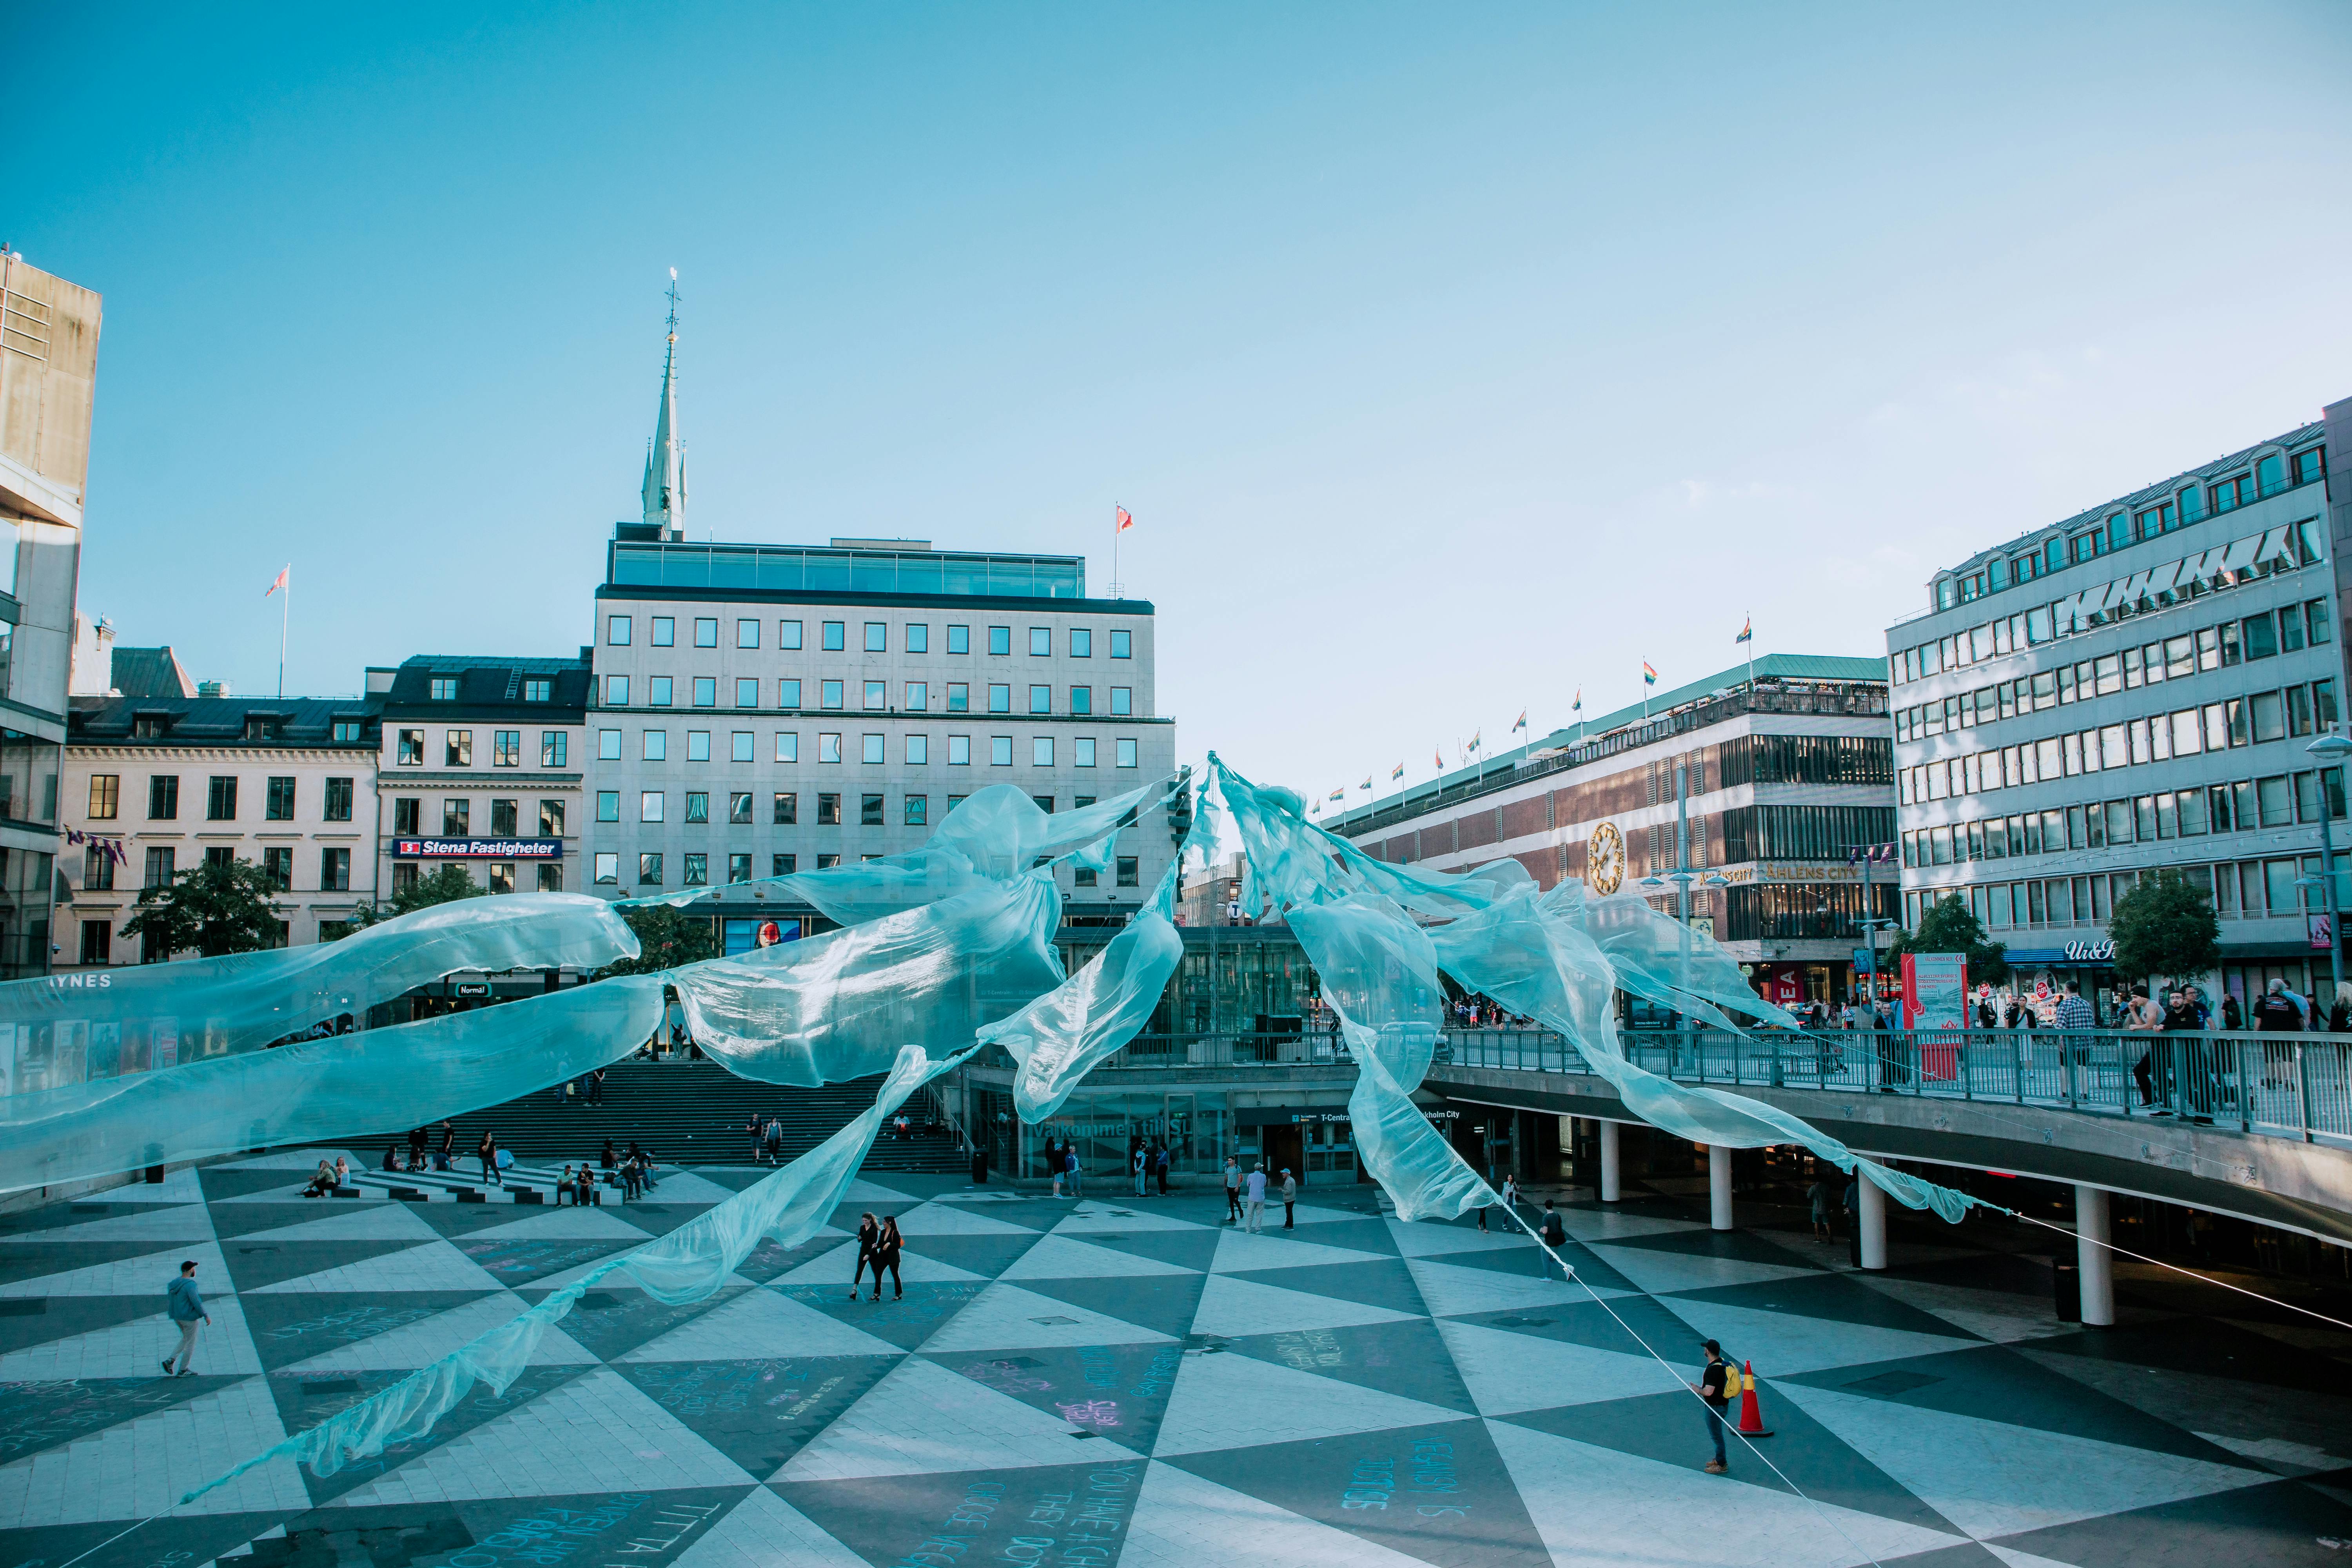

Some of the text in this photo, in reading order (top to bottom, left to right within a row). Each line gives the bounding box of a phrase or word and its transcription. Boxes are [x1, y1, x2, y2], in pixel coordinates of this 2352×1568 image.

[423, 841, 467, 854] Stena
[470, 842, 554, 856] Fastigheter
[1733, 868, 1752, 881] CITY
[1828, 867, 1859, 879] CITY
[461, 985, 485, 994] Normal
[1780, 971, 1795, 998] EA
[1141, 1119, 1164, 1136] till
[1169, 1119, 1194, 1136] SL
[1129, 1378, 1175, 1397] GAY
[1407, 1436, 1461, 1494] VEGANISM
[1089, 1465, 1136, 1492] YOU
[944, 1482, 1007, 1529] CHOOSE
[1026, 1491, 1074, 1528] THEY
[1071, 1495, 1127, 1532] HAVE
[436, 1508, 585, 1568] KÄNSLO
[1063, 1532, 1115, 1543] A
